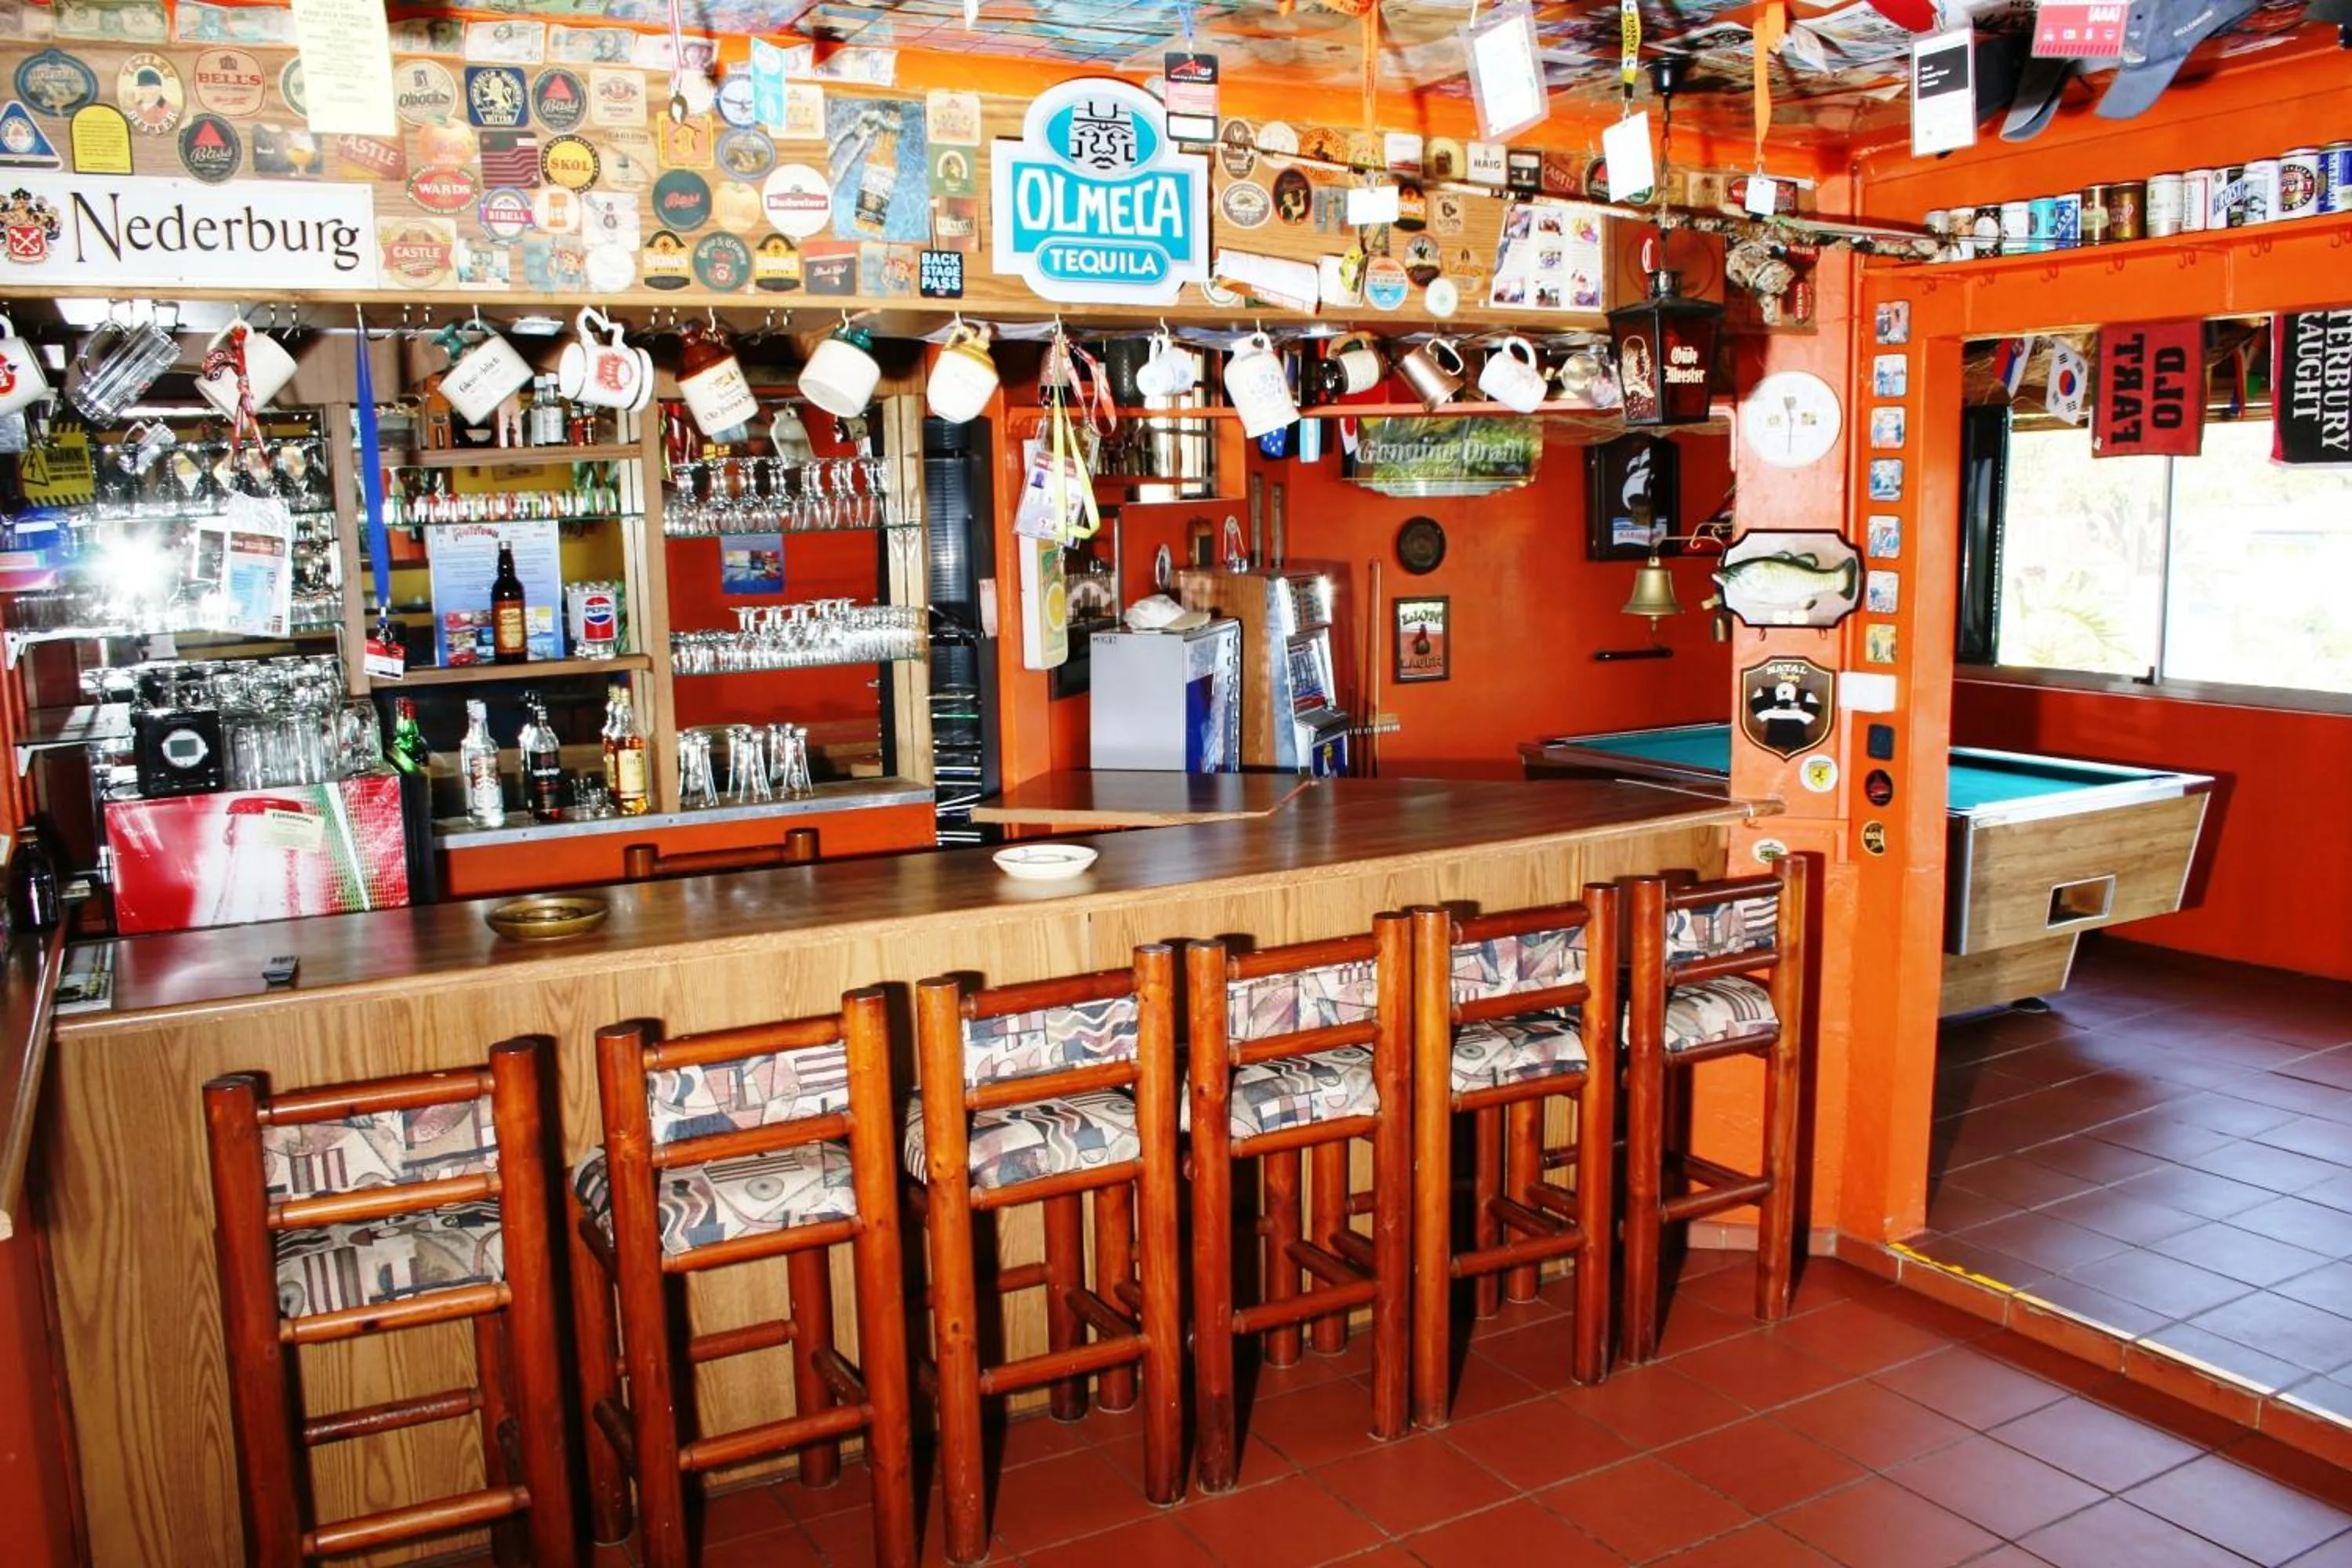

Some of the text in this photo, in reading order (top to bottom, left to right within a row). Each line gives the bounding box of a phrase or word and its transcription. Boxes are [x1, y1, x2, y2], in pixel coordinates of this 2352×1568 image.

[198, 72, 262, 85] BELL'S
[338, 134, 397, 165] CASTLE
[550, 158, 590, 172] SKOL
[1473, 158, 1501, 169] HAIG
[418, 183, 471, 195] WARDS
[768, 196, 827, 209] Budweiser
[1017, 168, 1184, 238] OLMECA
[71, 192, 360, 271] Nederburg
[393, 245, 441, 259] CASTLE
[921, 252, 960, 267] BACK
[1049, 249, 1159, 275] TEQUILA
[921, 266, 961, 278] STAGE
[921, 278, 961, 290] PASS
[1664, 365, 1706, 384] Meester
[1356, 438, 1458, 464] Genuine
[1401, 609, 1443, 626] LION
[1766, 663, 1808, 675] NATAL
